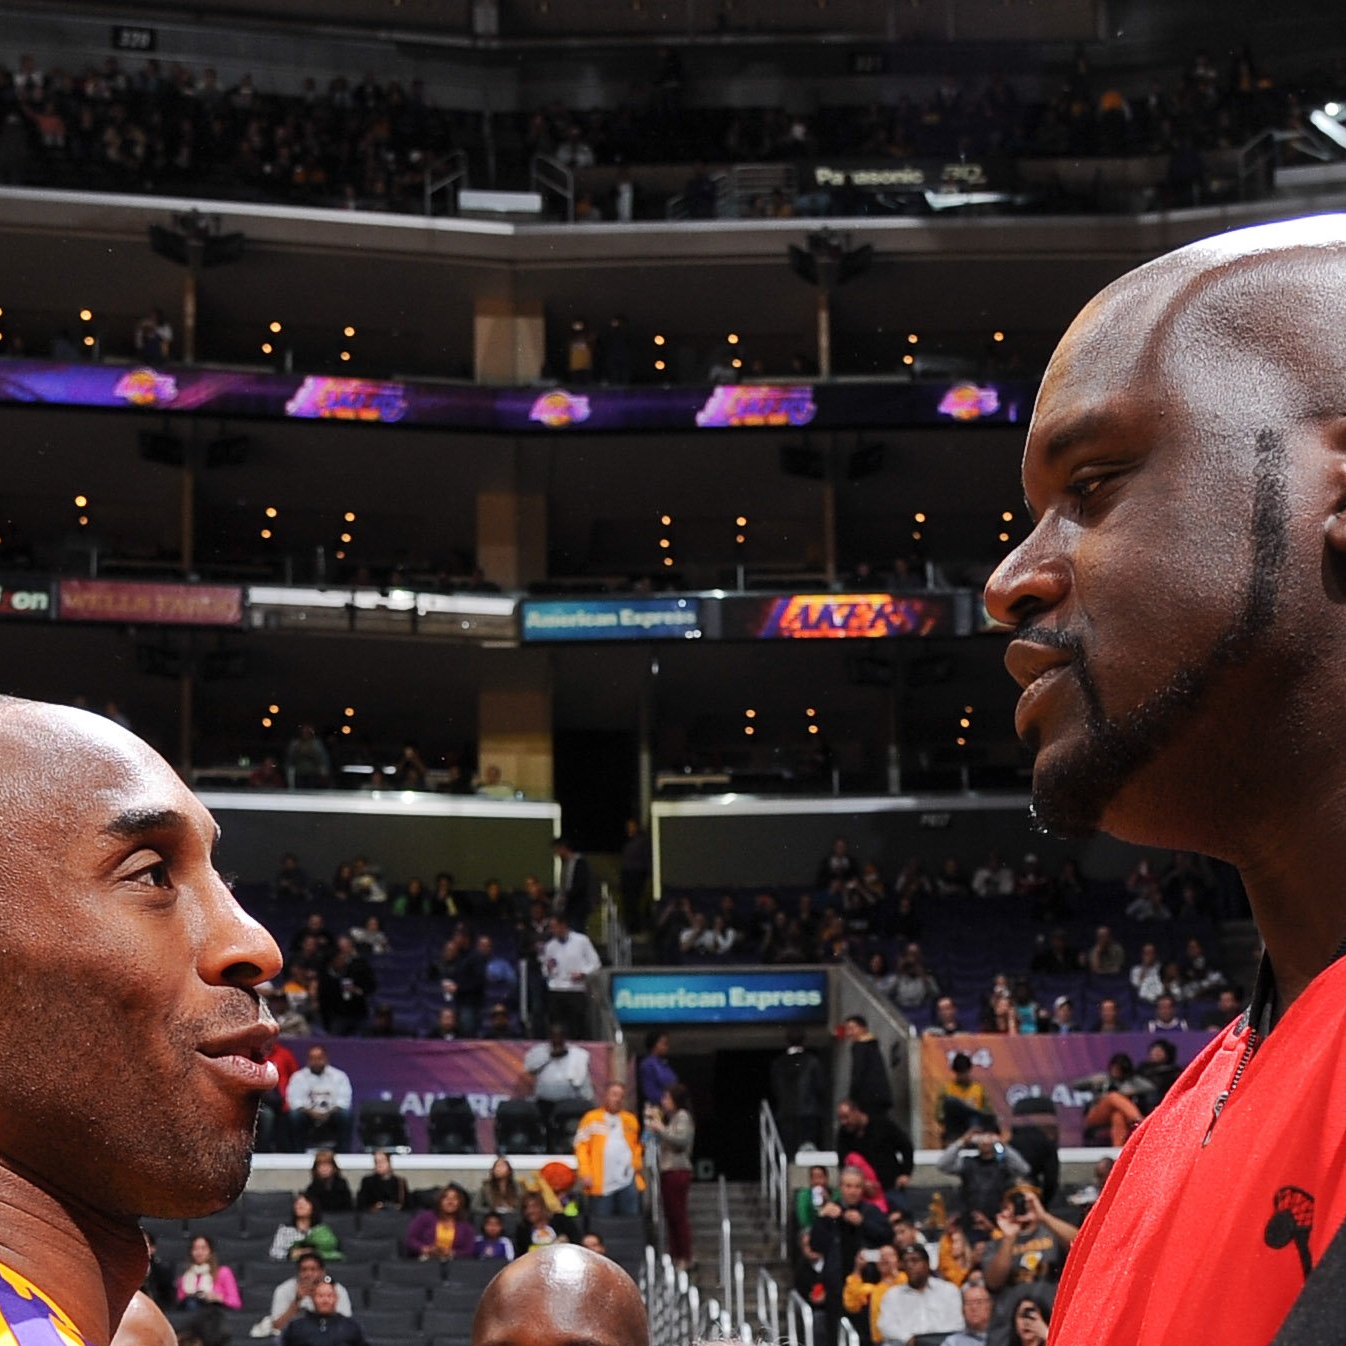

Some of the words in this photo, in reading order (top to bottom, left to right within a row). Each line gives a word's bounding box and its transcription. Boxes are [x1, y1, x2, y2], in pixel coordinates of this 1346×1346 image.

[525, 609, 618, 629] American
[620, 608, 697, 629] Express
[615, 987, 727, 1009] American
[728, 985, 822, 1011] Express
